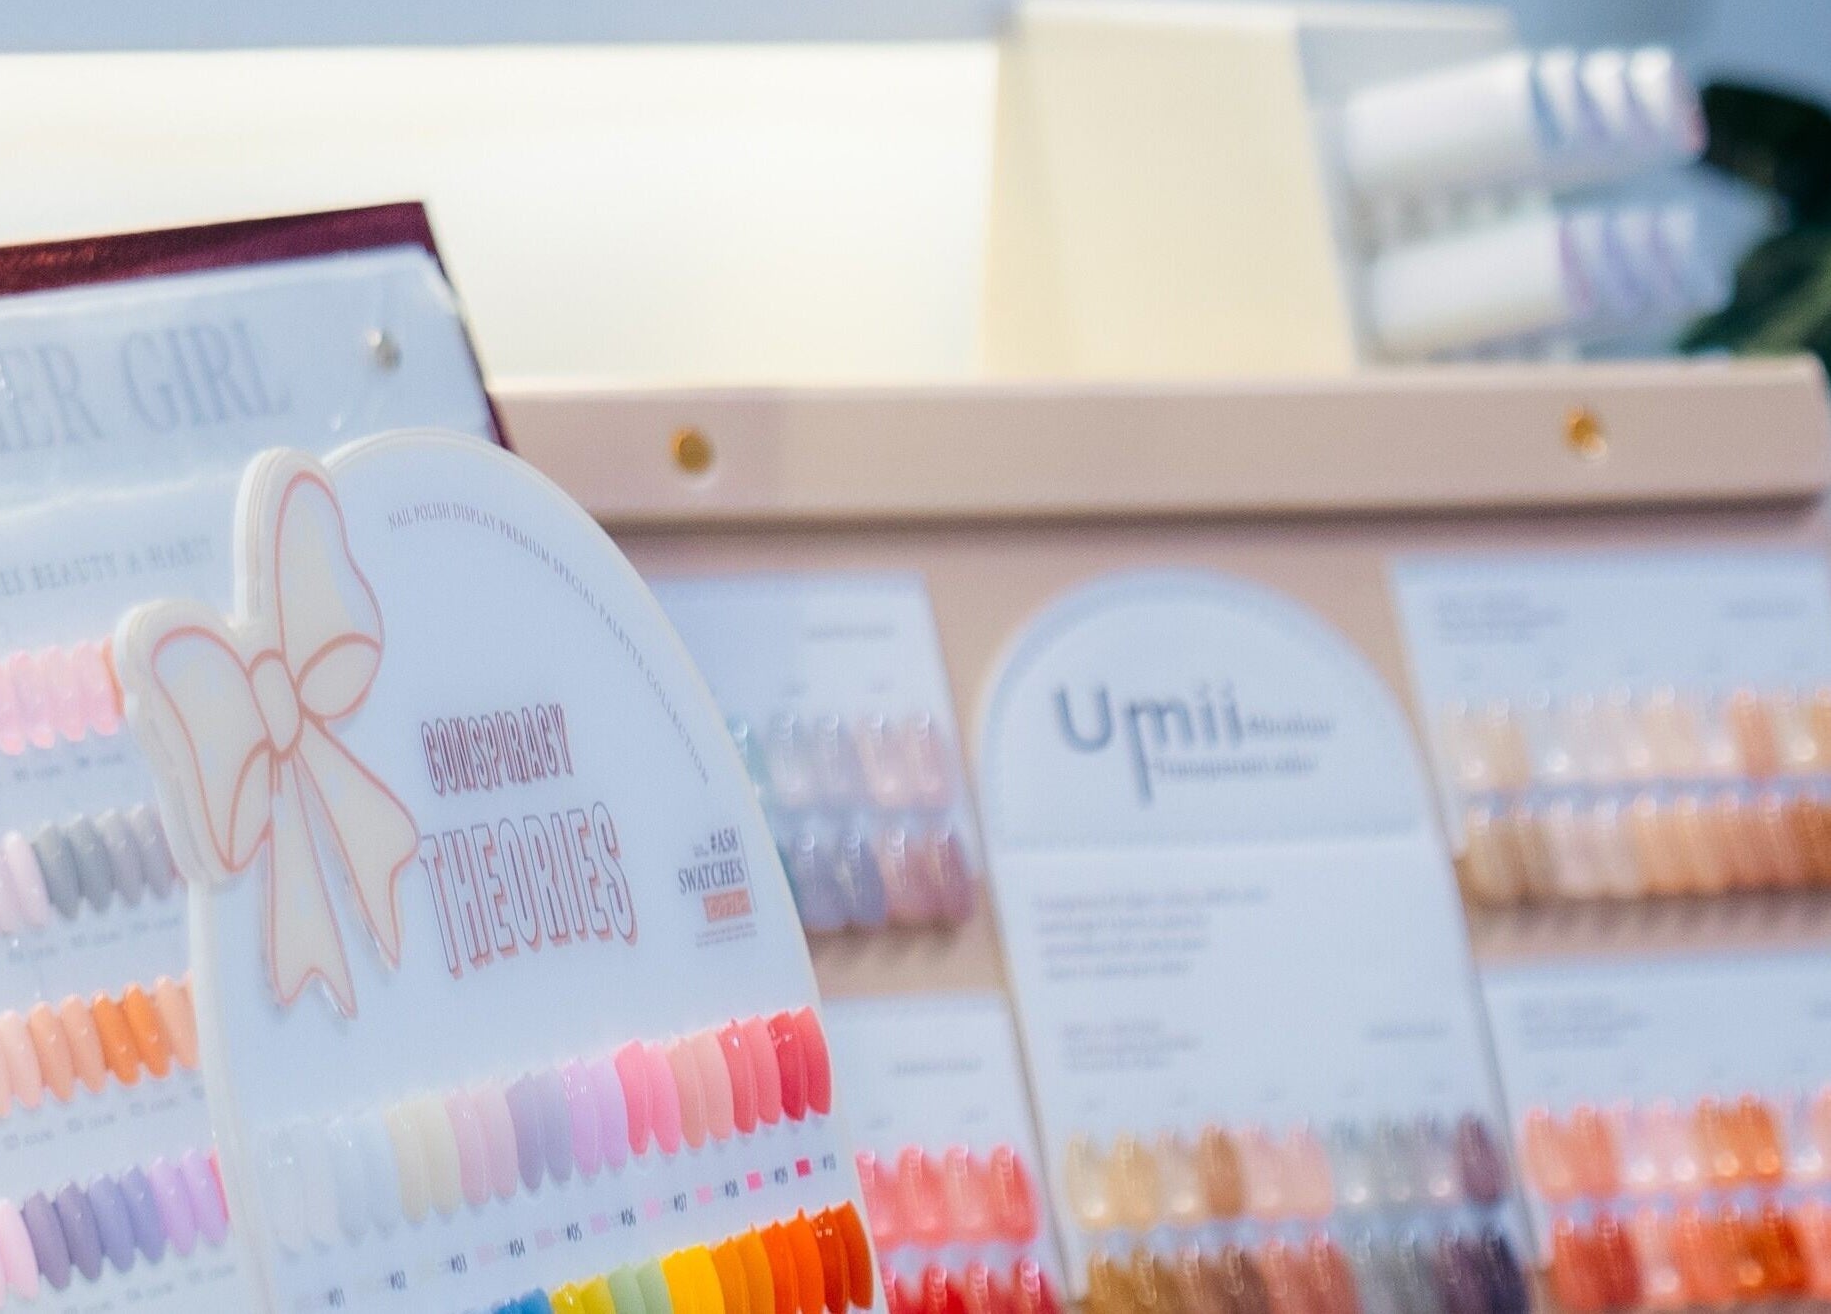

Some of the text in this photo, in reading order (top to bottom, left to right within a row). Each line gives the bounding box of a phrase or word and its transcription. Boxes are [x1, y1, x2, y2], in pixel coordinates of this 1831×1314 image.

[120, 317, 292, 436] GIRL
[388, 502, 711, 785] NAIL POLISH DISPLAY PREMIUM SPECIAL PALETTE COLLECTION
[420, 703, 574, 798] CONSPIRACY
[419, 800, 639, 980] THEORIES
[678, 857, 746, 895] SWATCHES
[509, 1237, 526, 1258] #04
[566, 1222, 582, 1242] #05
[621, 1207, 636, 1227] #06
